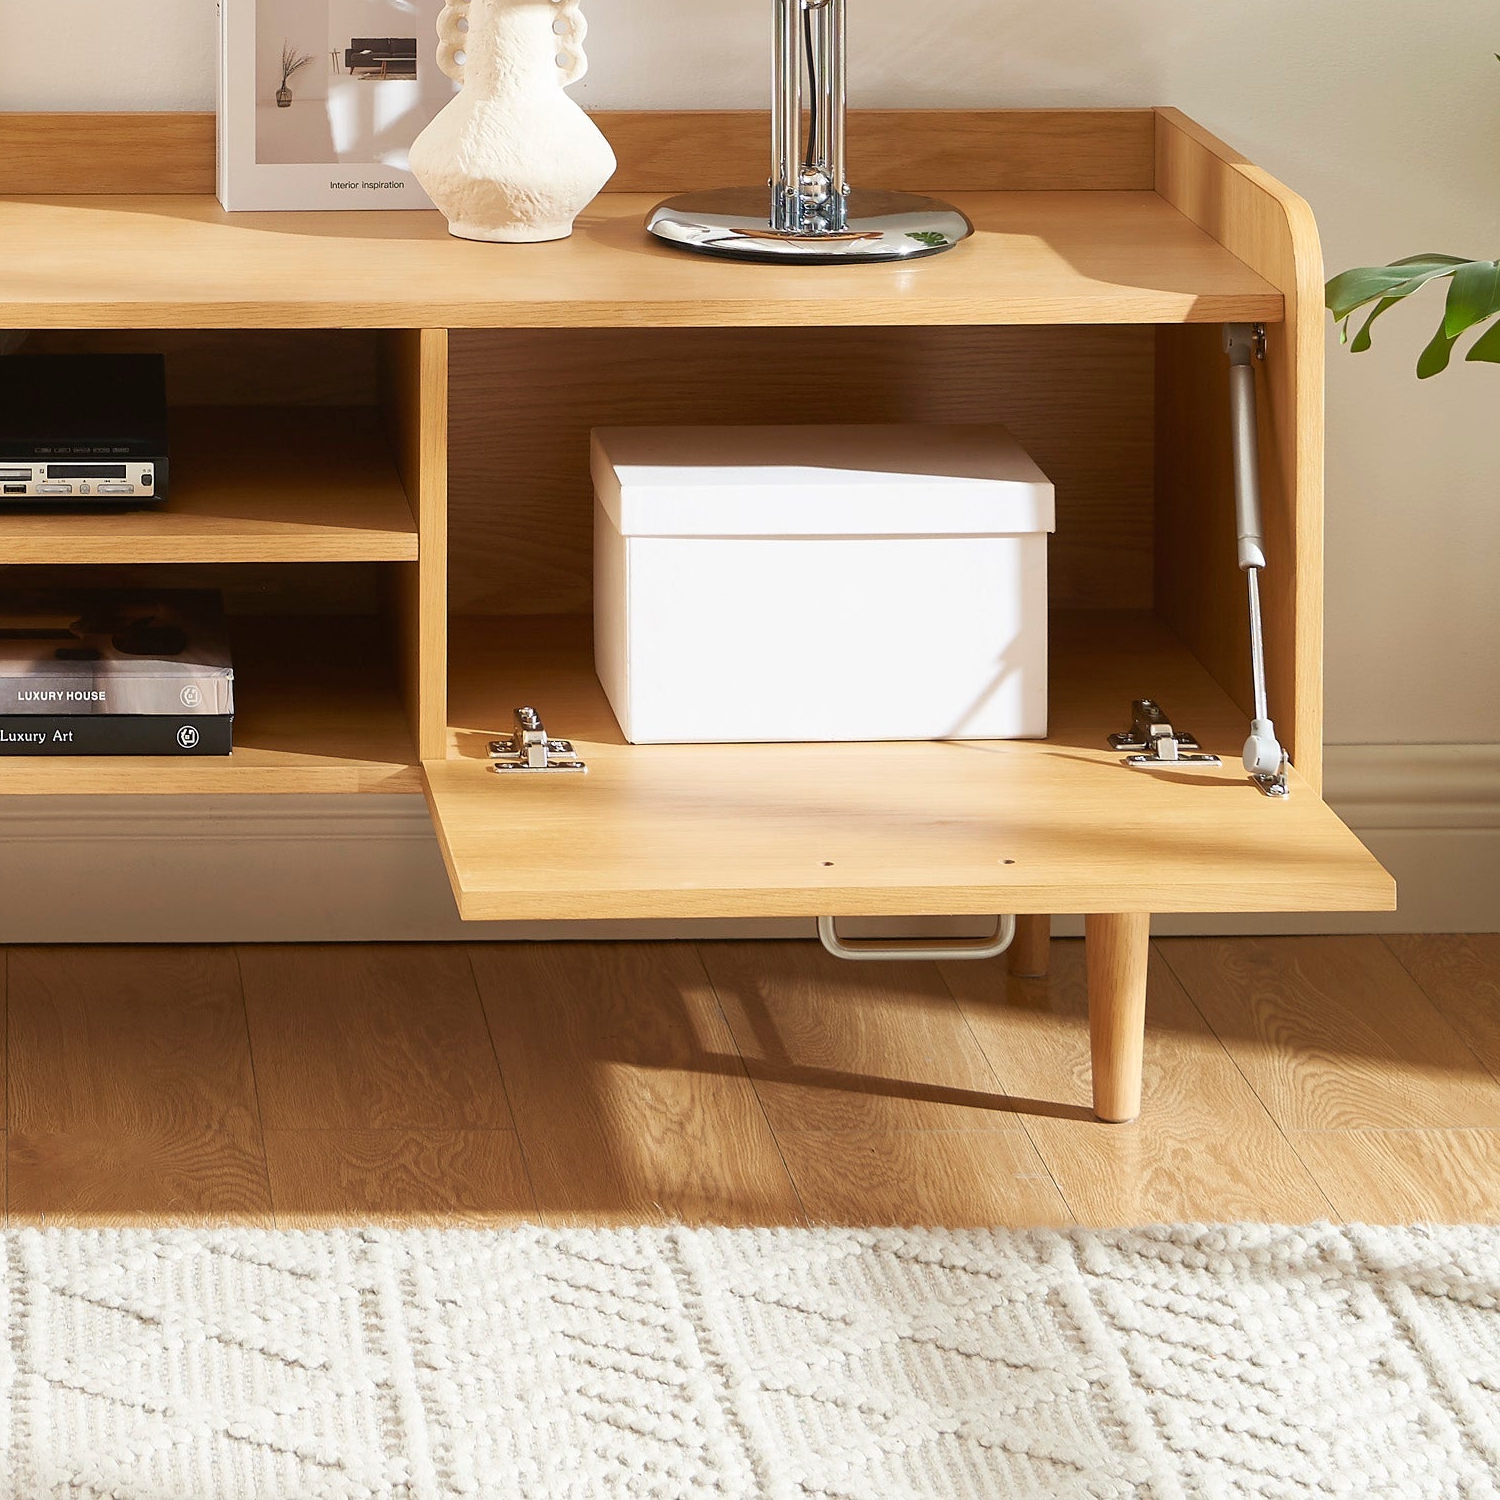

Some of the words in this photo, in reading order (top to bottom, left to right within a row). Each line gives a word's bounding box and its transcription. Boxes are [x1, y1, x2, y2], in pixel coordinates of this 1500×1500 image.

[330, 181, 359, 189] Interior
[361, 181, 405, 190] inspiration
[17, 691, 64, 701] LUXURY
[66, 691, 106, 701] HOUSE
[0, 729, 46, 745] Luxury
[52, 729, 74, 742] Art
